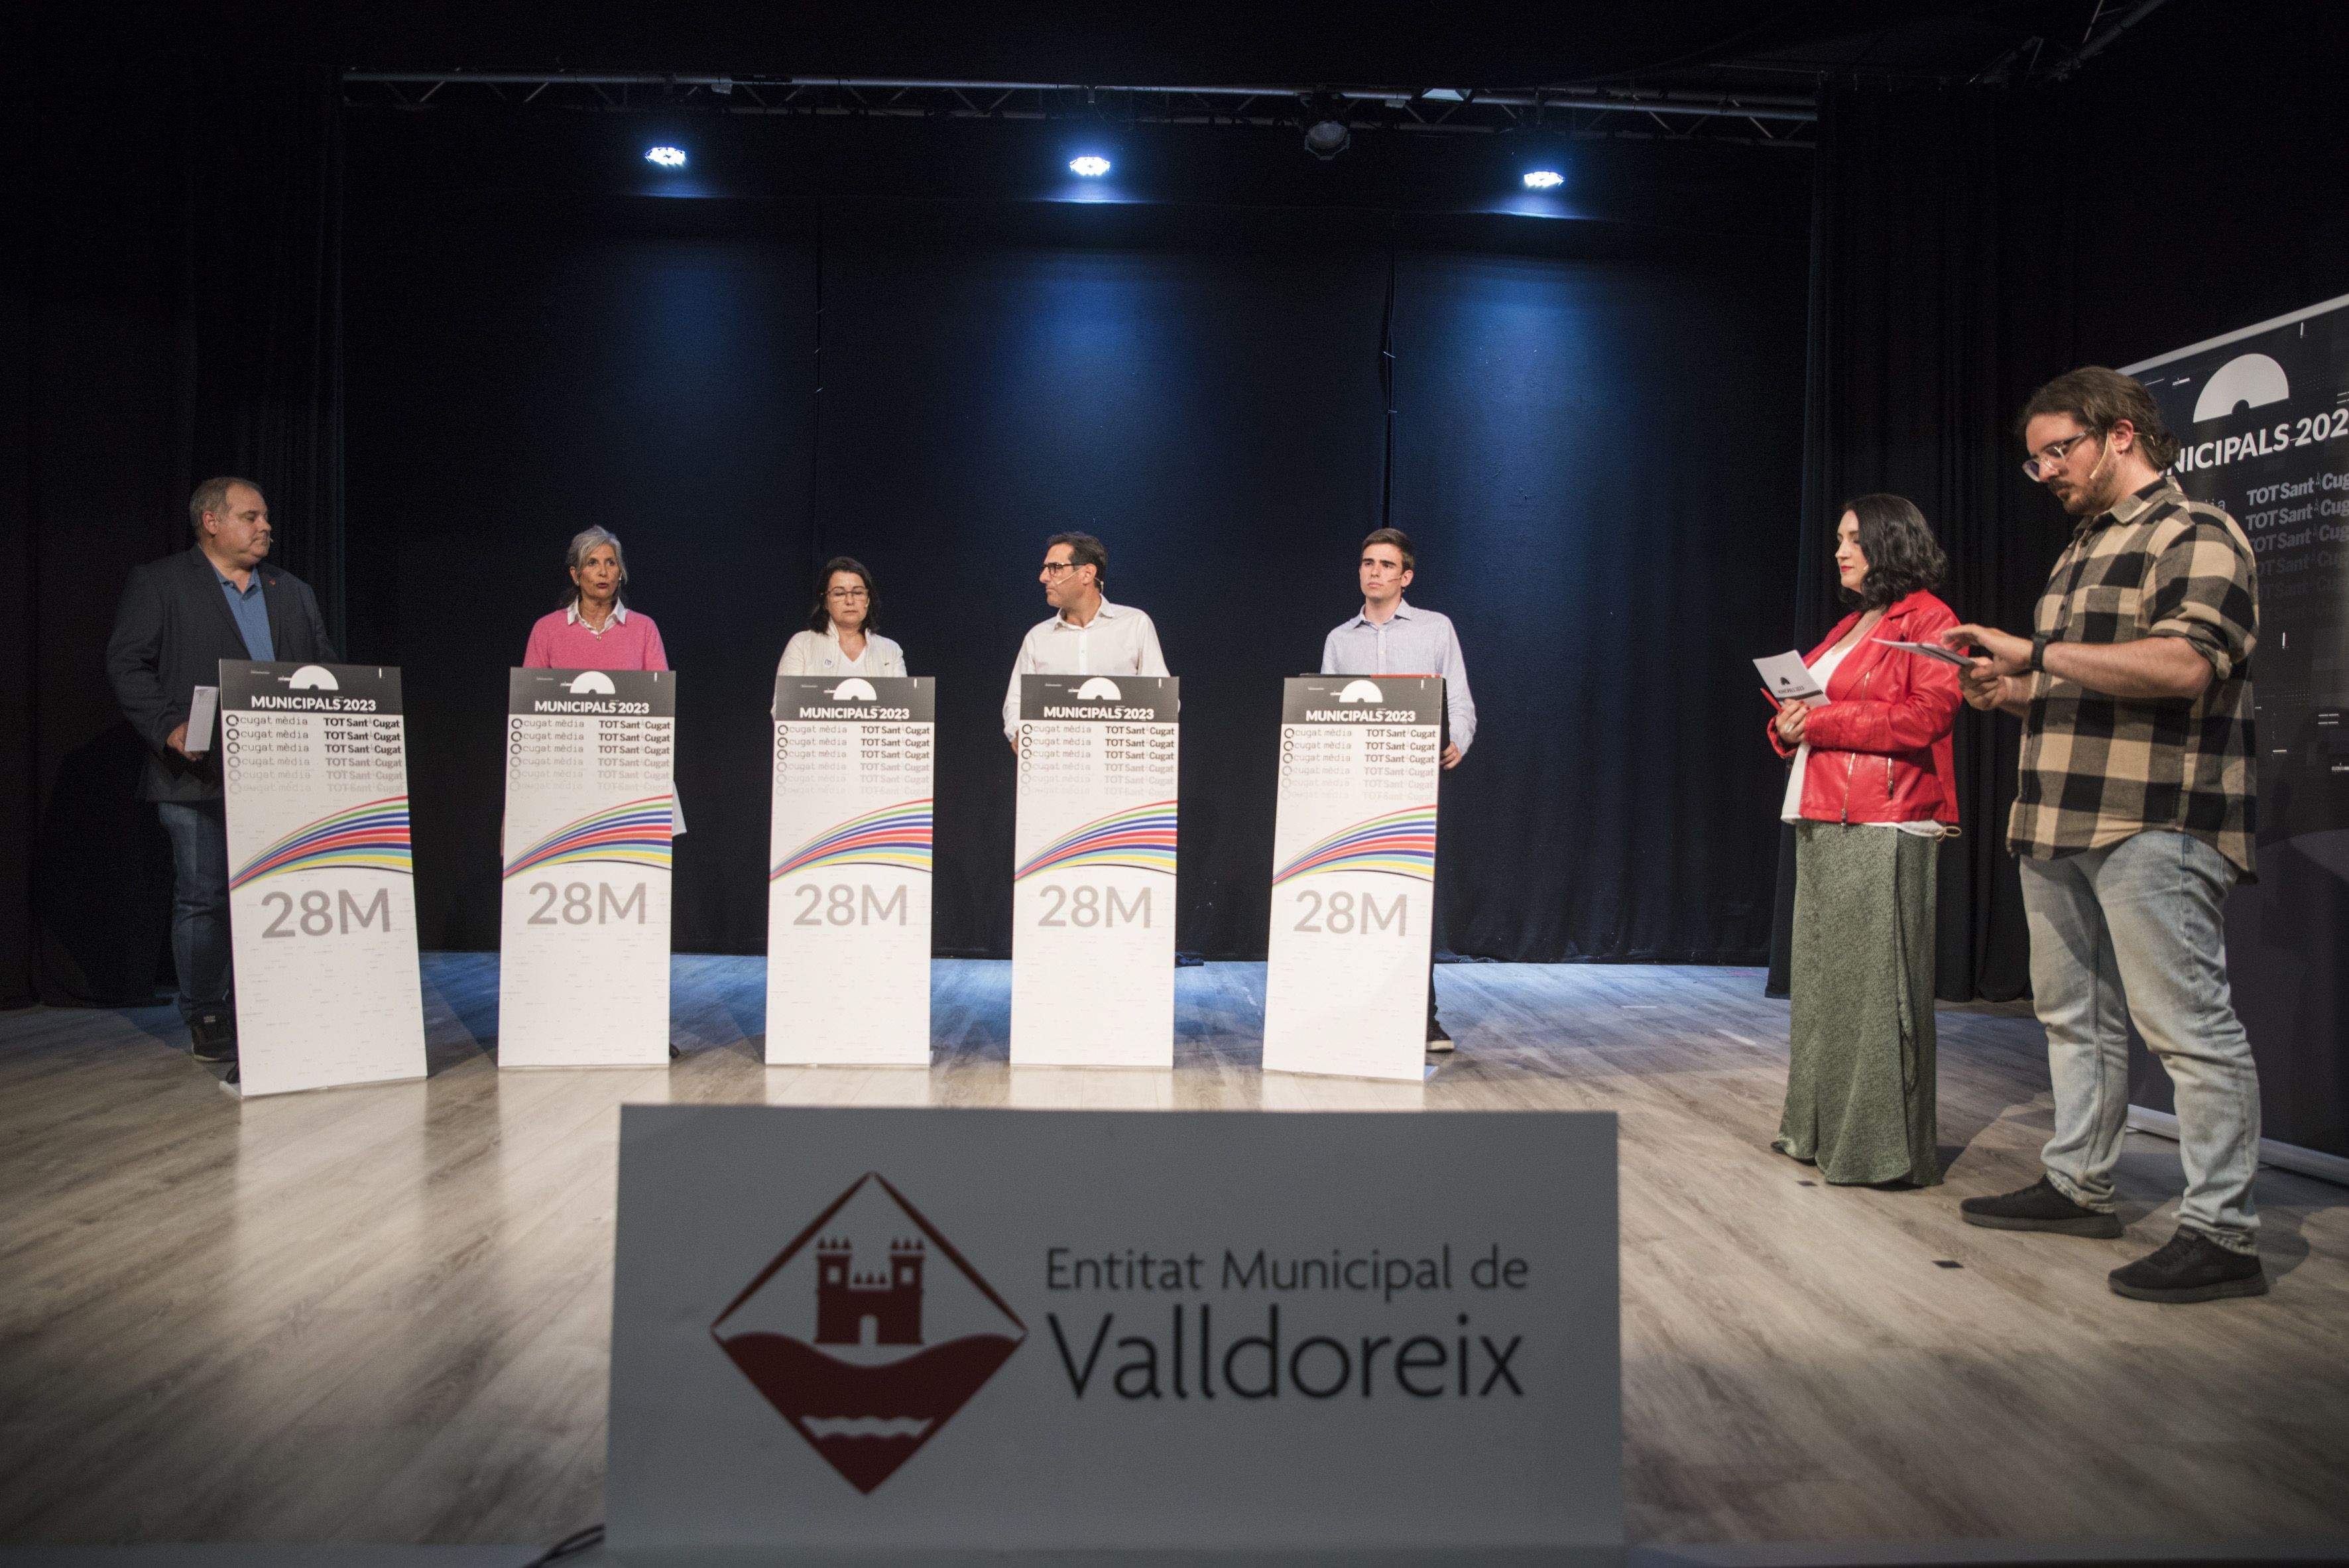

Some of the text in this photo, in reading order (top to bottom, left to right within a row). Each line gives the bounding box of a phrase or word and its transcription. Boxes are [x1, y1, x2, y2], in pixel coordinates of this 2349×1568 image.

[2159, 408, 2349, 477] NICIPALS 202
[2246, 485, 2279, 506] TOT
[2280, 477, 2314, 499] Sant
[2322, 473, 2349, 490] Cug
[2245, 499, 2349, 530] TOT Sant Cug
[2320, 524, 2349, 542] Cug
[251, 696, 377, 711] MUNICIPALS 2023
[534, 701, 650, 714] MUNICIPALS 2023
[800, 707, 910, 719] MUNICIPALS 2023
[1044, 706, 1154, 719] MUNICIPALS 2023
[1306, 710, 1415, 722] MUNICIPALS 2023
[240, 716, 272, 726] cugat
[324, 717, 399, 729] TOT Sant Cugat
[524, 720, 552, 729] cugat
[645, 721, 670, 731] Cugat
[241, 730, 308, 740] cugat mèdia
[789, 726, 816, 735] cugat
[906, 727, 930, 735] Cugat
[1150, 727, 1174, 736] Cugat
[1295, 729, 1321, 738] cugat
[1412, 729, 1435, 739] Cugat
[325, 731, 400, 743] TOT Sant Cugat
[645, 734, 670, 743] Cugat
[789, 738, 815, 747] cugat
[905, 739, 930, 748] Cugat
[1033, 738, 1060, 747] cugat
[1150, 739, 1174, 749] Cugat
[1294, 742, 1321, 751] cugat
[1410, 743, 1435, 752] Cugat
[241, 743, 273, 753] cugat
[326, 744, 347, 753] TOT
[375, 745, 400, 755] Cugat
[644, 746, 670, 756] Cugat
[905, 751, 930, 760] Cugat
[1150, 752, 1174, 761] Cugat
[1410, 755, 1434, 764] Cugat
[326, 758, 347, 766] TOT
[375, 758, 402, 769] Cugat
[644, 759, 669, 768] Cugat
[904, 763, 929, 772] Cugat
[1149, 764, 1174, 774] Cugat
[1409, 768, 1434, 778] Cugat
[527, 882, 646, 925] 28M
[793, 884, 908, 927] 28M
[1038, 884, 1152, 928] 28M
[262, 888, 391, 938] 28M
[1294, 890, 1408, 937] 28M
[1045, 1243, 1530, 1303] Entitat Municipal de
[1045, 1304, 1525, 1400] Valldoreix
